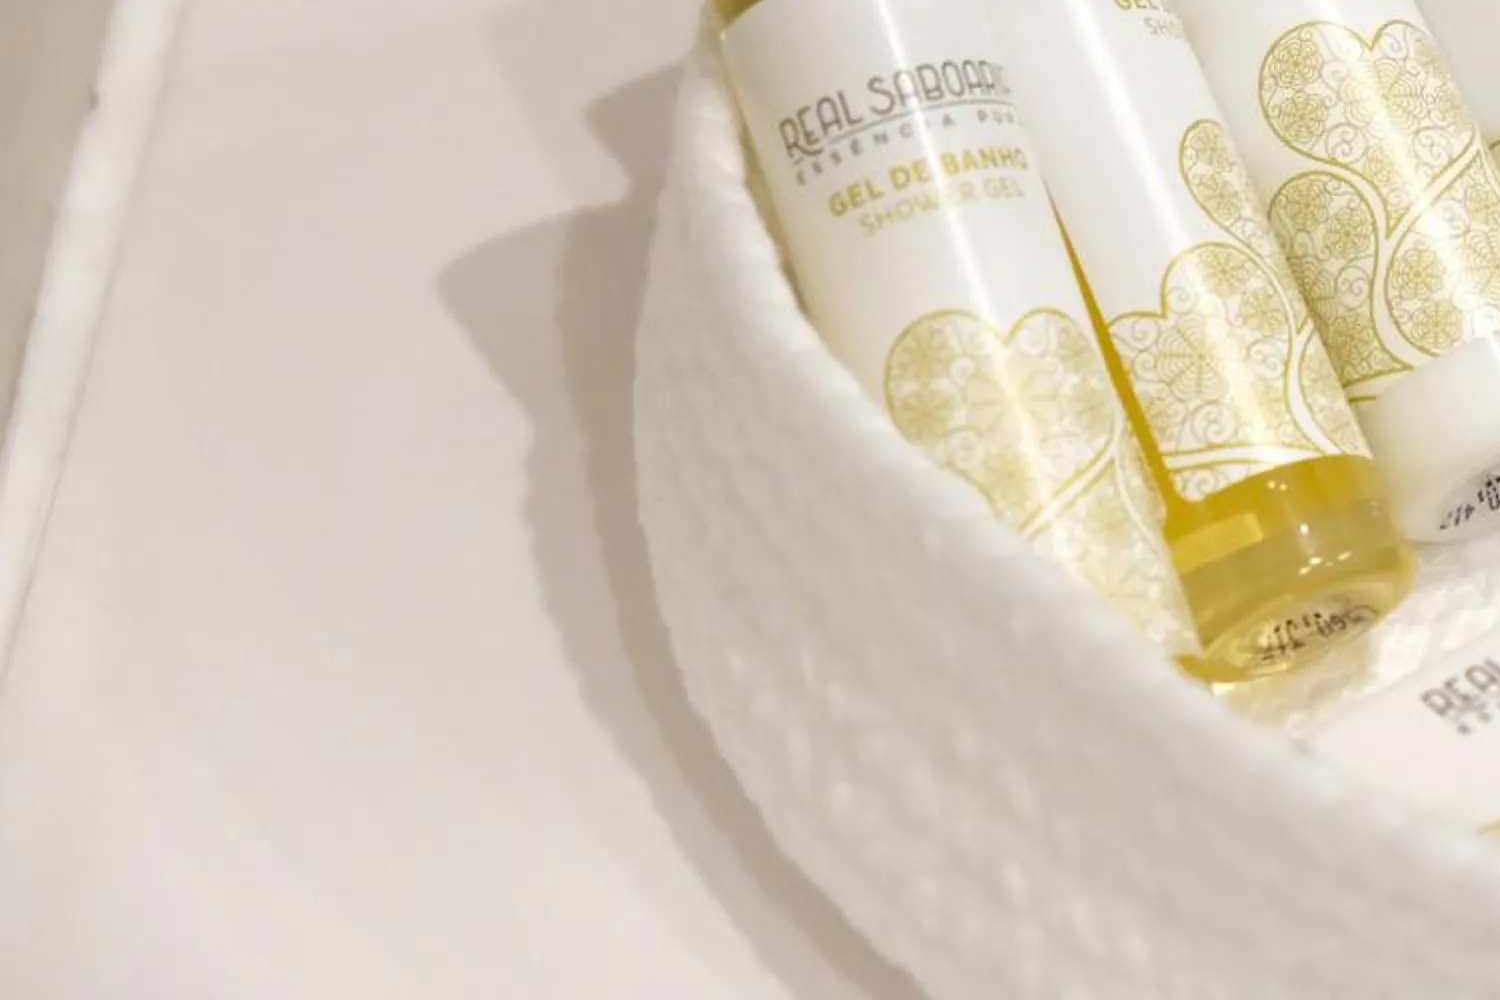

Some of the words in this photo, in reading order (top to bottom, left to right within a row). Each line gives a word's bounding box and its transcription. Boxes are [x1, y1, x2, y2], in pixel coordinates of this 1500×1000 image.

[778, 90, 865, 159] REAL
[828, 176, 884, 217] GEL
[889, 160, 931, 189] DE
[859, 183, 976, 236] SHOWR
